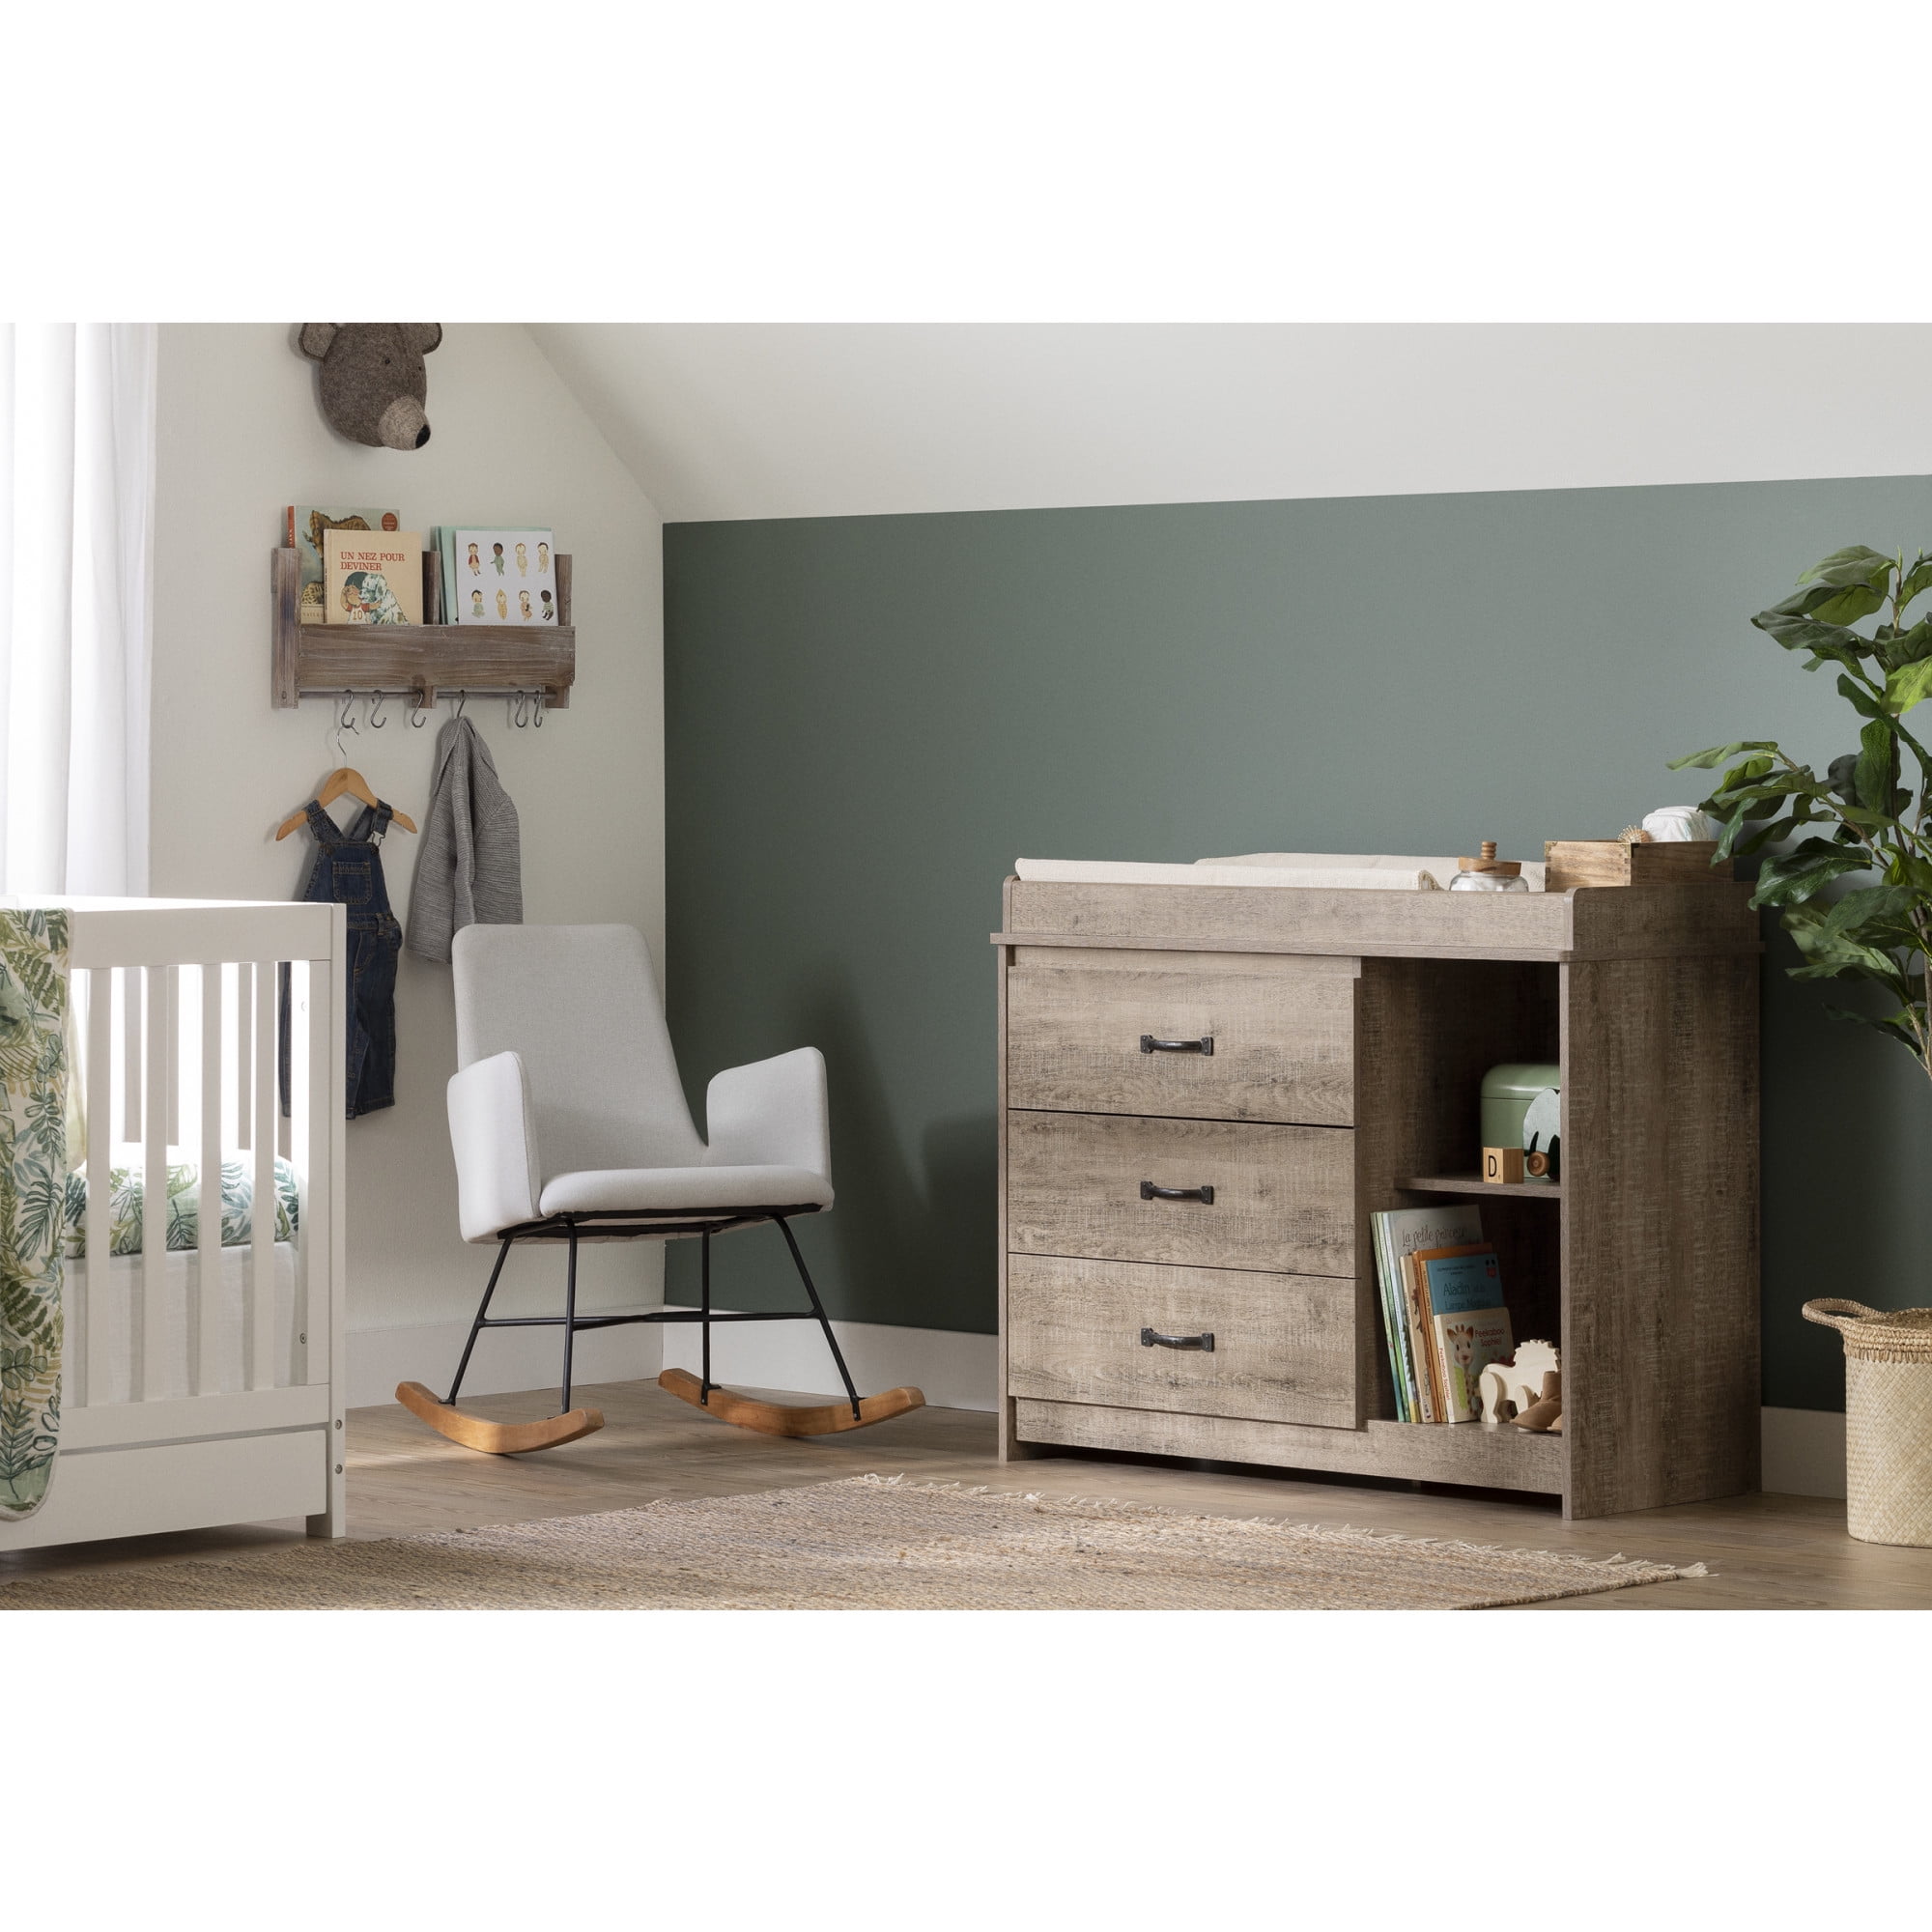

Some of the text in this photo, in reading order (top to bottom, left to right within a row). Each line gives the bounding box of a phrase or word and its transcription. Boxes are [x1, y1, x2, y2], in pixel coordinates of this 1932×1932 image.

[340, 552, 405, 562] UN NEZ POUR
[340, 562, 383, 571] DEVINER
[353, 611, 362, 620] 10
[1489, 1155, 1496, 1177] D
[1402, 1228, 1410, 1248] La
[1413, 1224, 1434, 1250] petite
[1443, 1281, 1470, 1295] Aladin
[1475, 1327, 1505, 1338] Peekaboo
